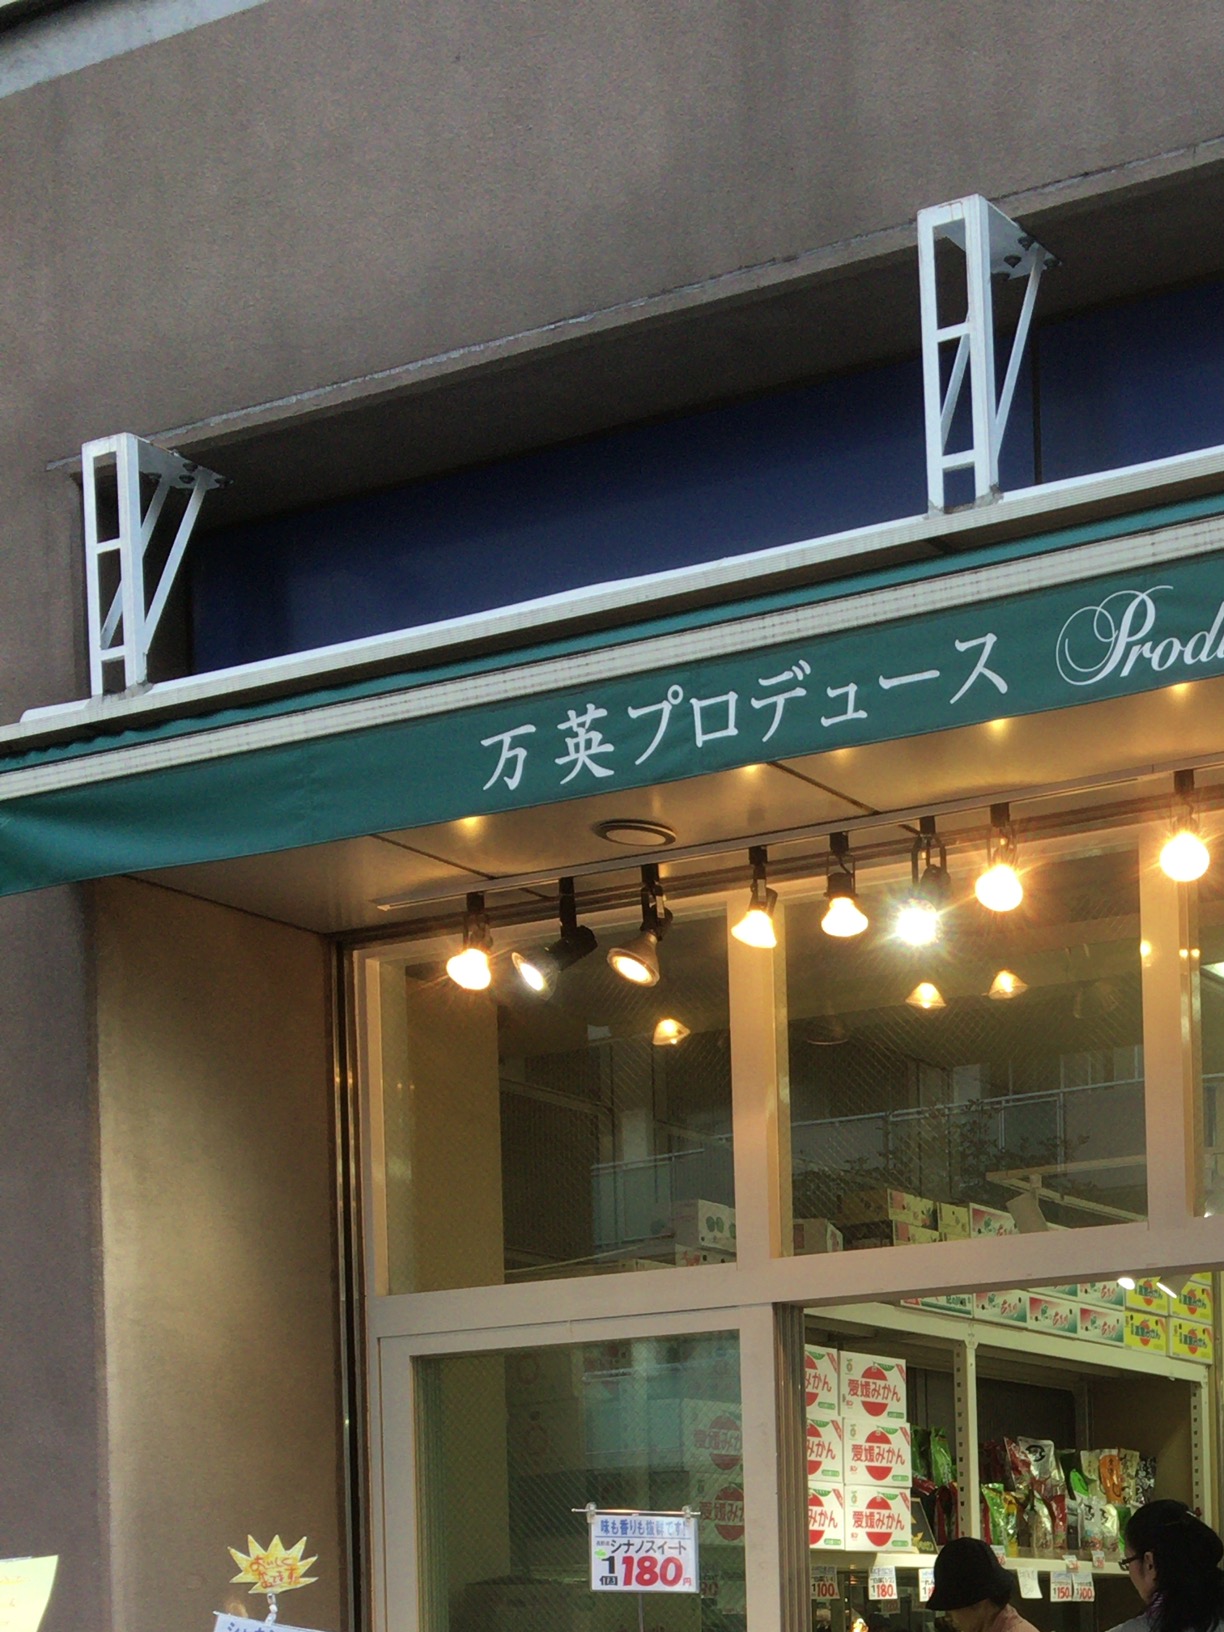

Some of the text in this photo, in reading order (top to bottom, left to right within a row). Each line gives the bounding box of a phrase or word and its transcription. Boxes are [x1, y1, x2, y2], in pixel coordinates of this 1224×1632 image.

[480, 632, 1009, 792] 万英プロデュース
[848, 1379, 901, 1403] 愛媛みかん
[852, 1443, 905, 1466] 愛媛みかん
[853, 1510, 905, 1531] 愛媛みかん
[610, 1539, 687, 1555] シナノスイート
